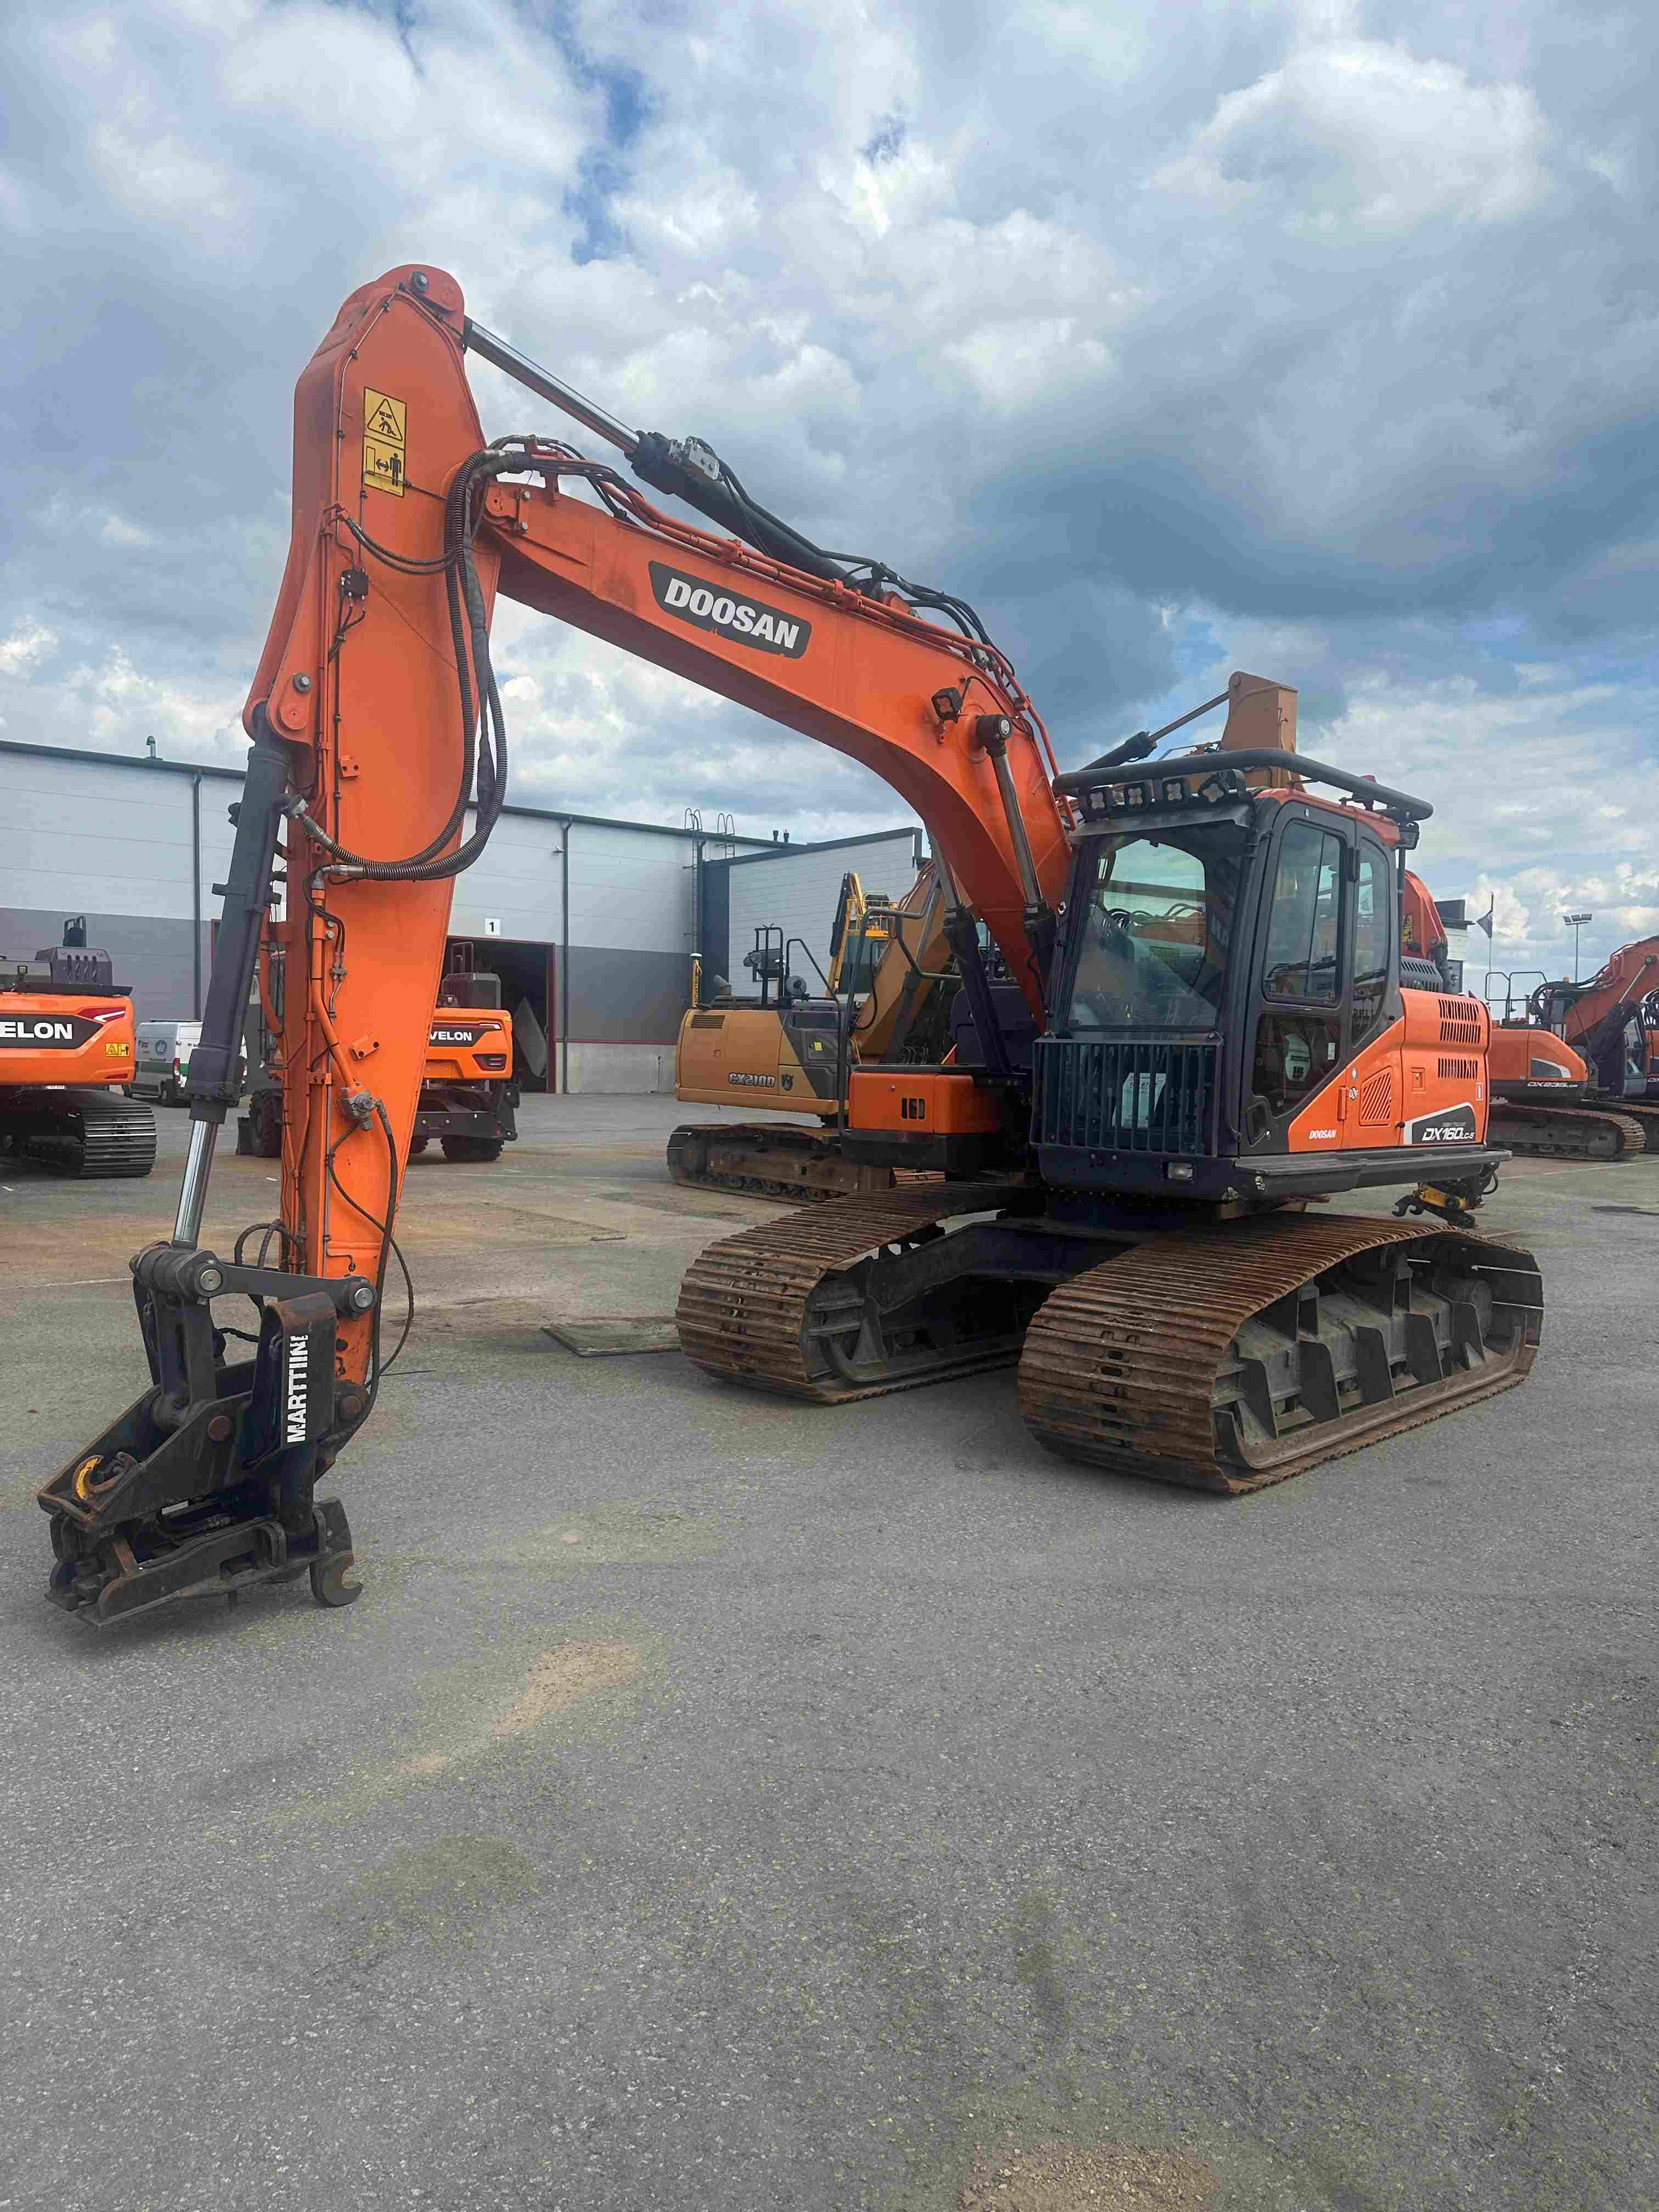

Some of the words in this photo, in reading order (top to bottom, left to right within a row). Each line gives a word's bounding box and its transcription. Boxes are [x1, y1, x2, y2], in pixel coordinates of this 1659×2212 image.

[664, 578, 799, 649] DOOSAN
[489, 922, 494, 932] 1
[0, 1021, 72, 1040] ELON
[430, 1031, 472, 1041] VELON
[729, 1073, 775, 1087] CX210D
[901, 1097, 925, 1119] 160
[1308, 1129, 1337, 1139] DOOSAN
